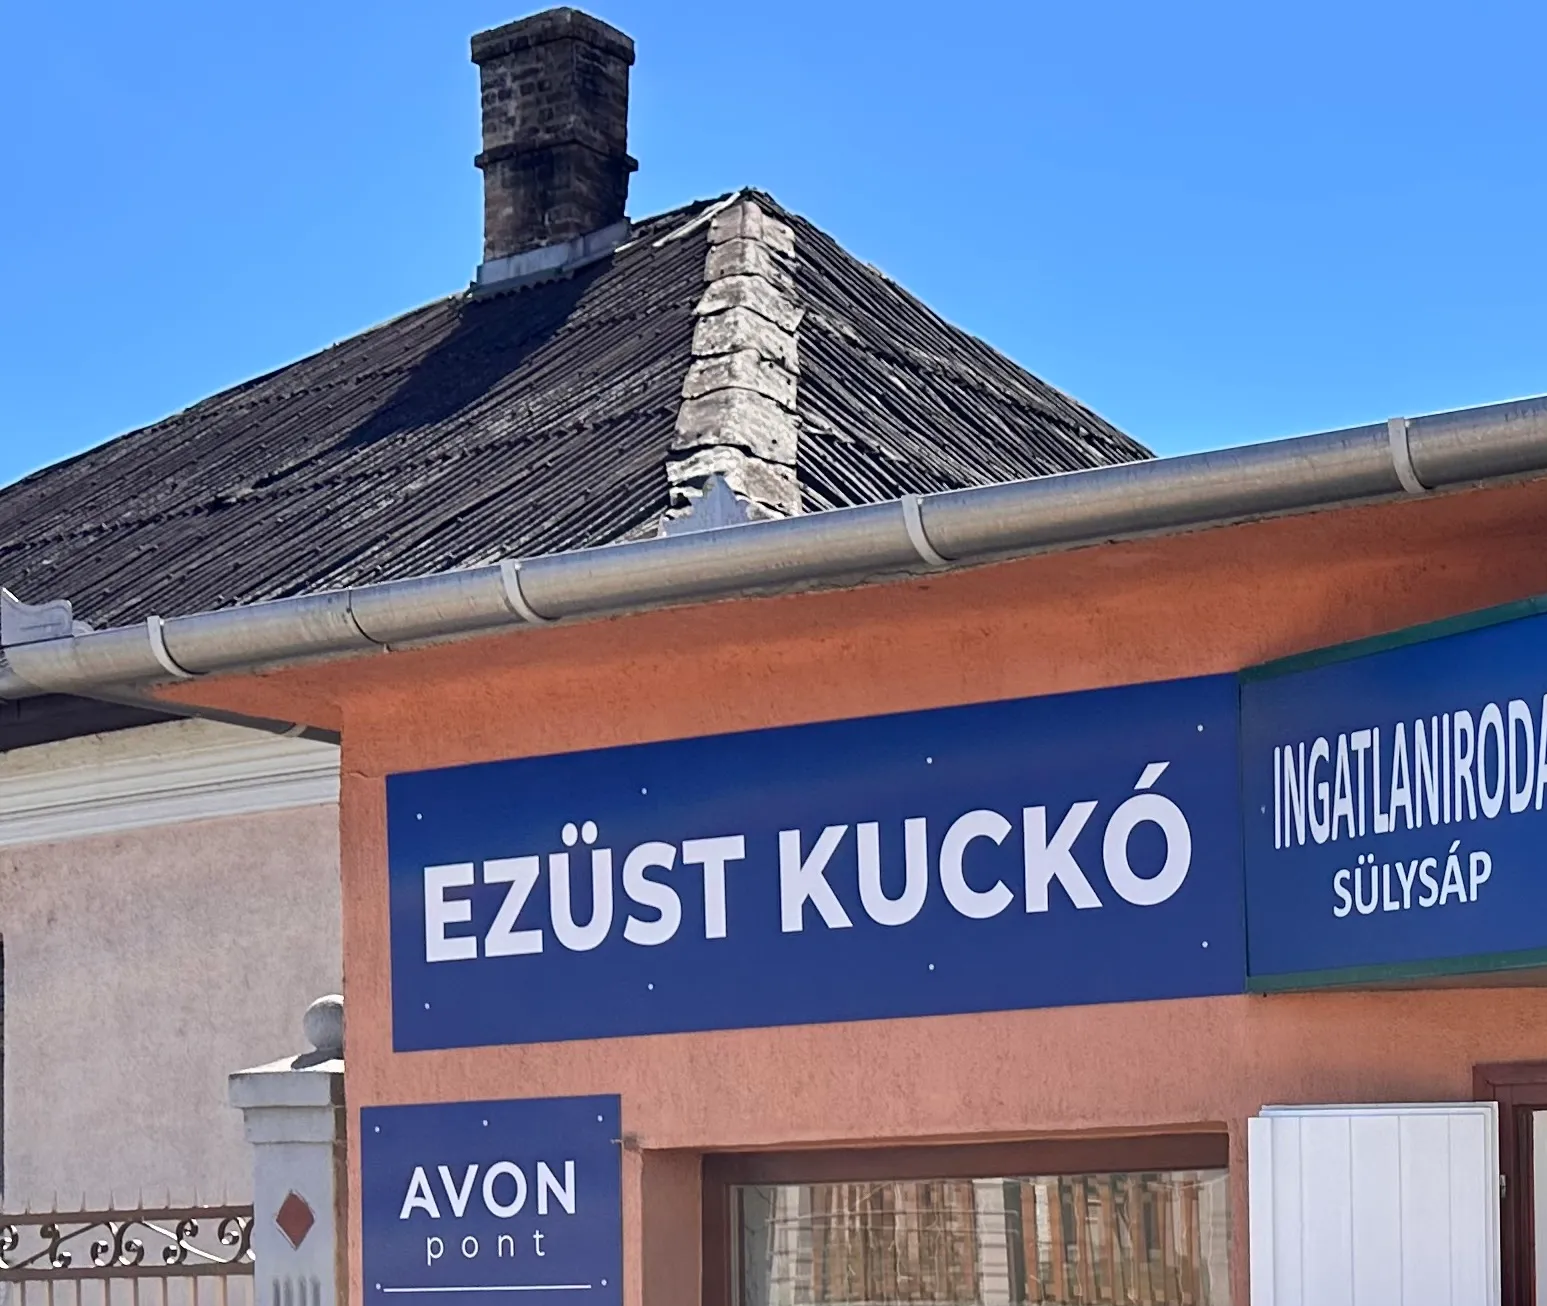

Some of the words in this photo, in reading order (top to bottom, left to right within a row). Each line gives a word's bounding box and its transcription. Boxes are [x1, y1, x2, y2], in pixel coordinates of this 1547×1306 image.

[424, 820, 747, 964] EZÜST
[776, 761, 1193, 935] KUCKÓ
[1332, 839, 1493, 918] SÜLYSÁP
[399, 1160, 576, 1219] AVON
[426, 1229, 546, 1266] pont
